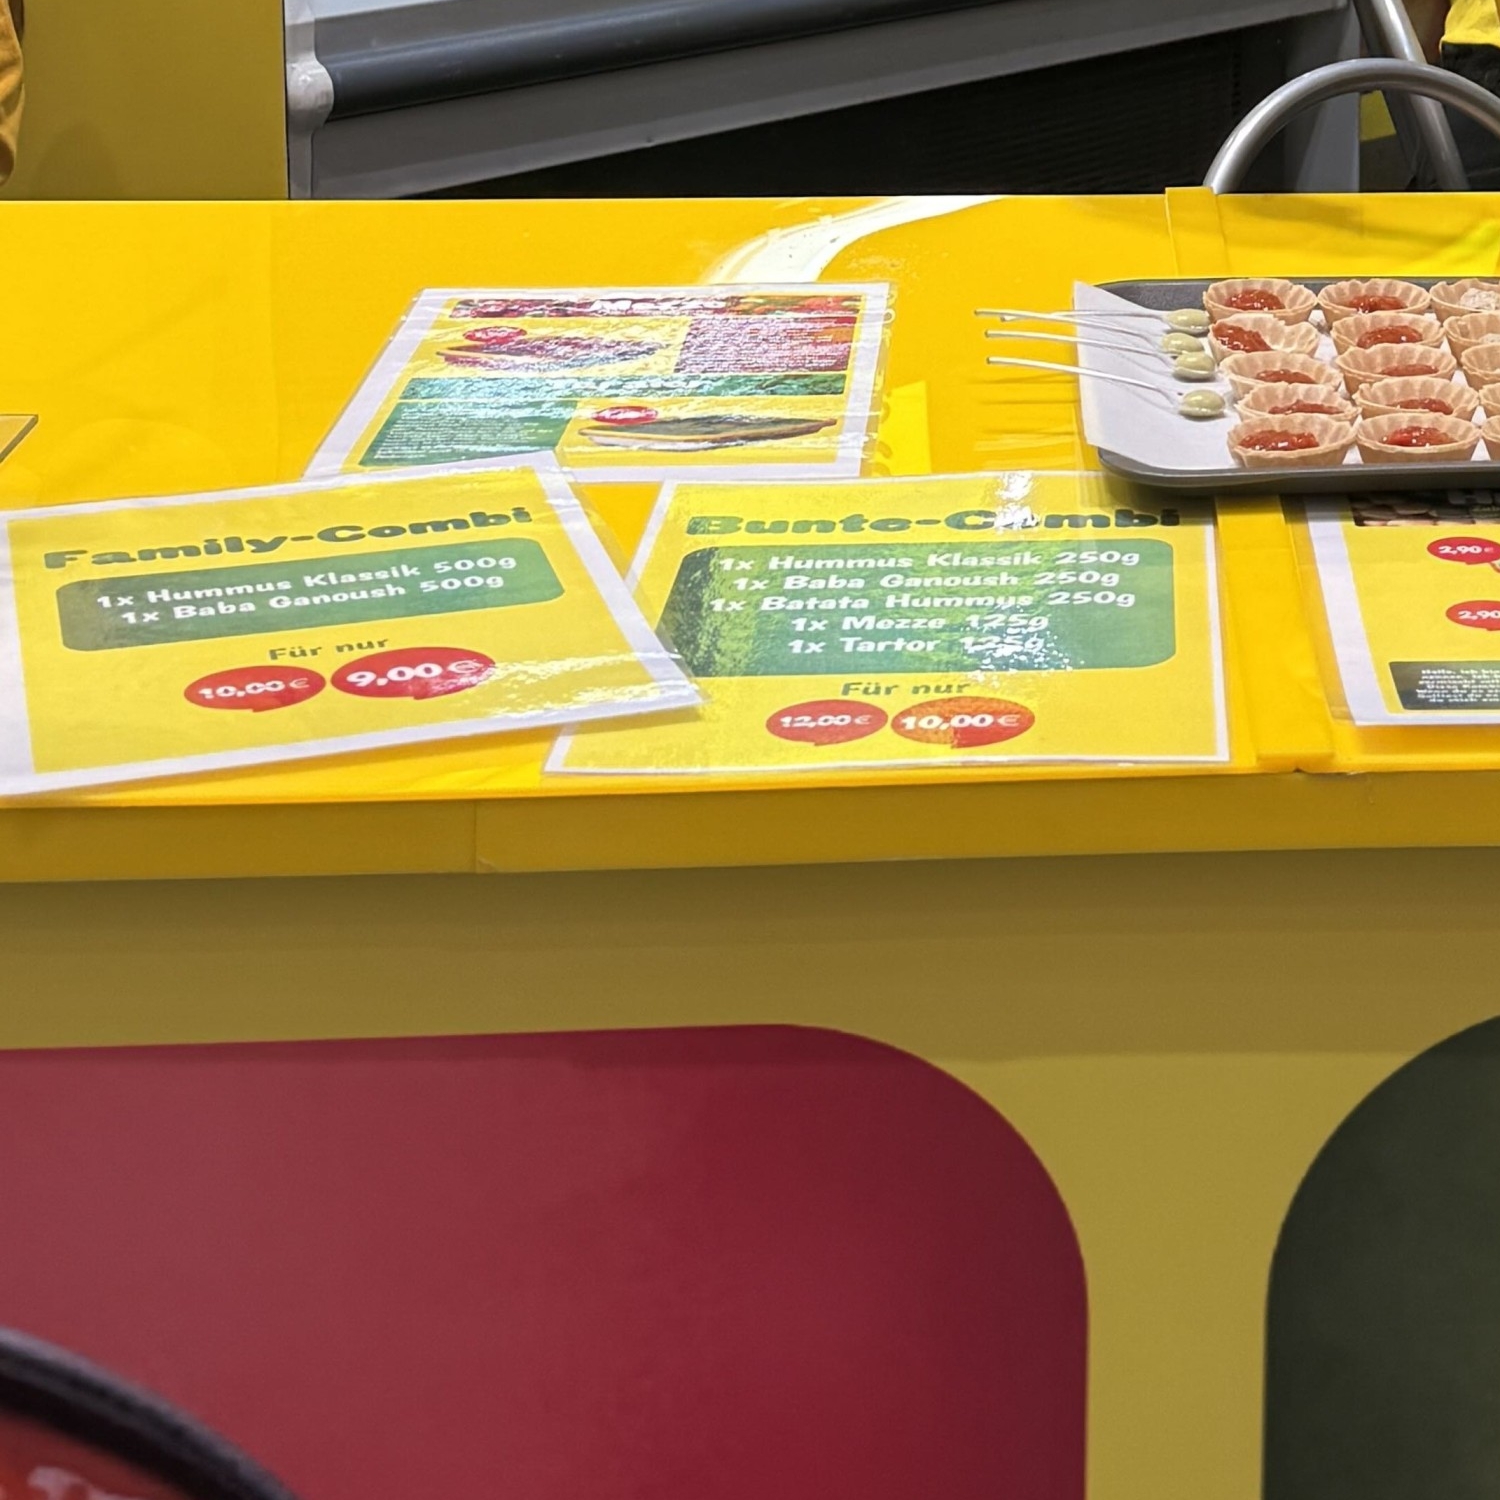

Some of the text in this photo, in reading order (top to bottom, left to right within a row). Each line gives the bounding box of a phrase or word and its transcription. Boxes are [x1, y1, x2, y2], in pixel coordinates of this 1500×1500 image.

[43, 507, 532, 569] Family-Combi
[719, 550, 1140, 571] 1x Hummus Klassik 250g
[97, 557, 517, 608] 1x Hummus Klassik 500g
[733, 570, 1120, 591] 1x Baba Ganoush 250g
[121, 576, 505, 624] 1x Baba Ganoush 500g
[709, 591, 1136, 612] 1x Batata Hummus 250g
[791, 613, 1049, 632] 1x Mezze 125g
[268, 639, 388, 661] Für nur
[788, 639, 827, 653] 1x
[840, 637, 941, 652] Tartor
[841, 682, 971, 696] Für nur
